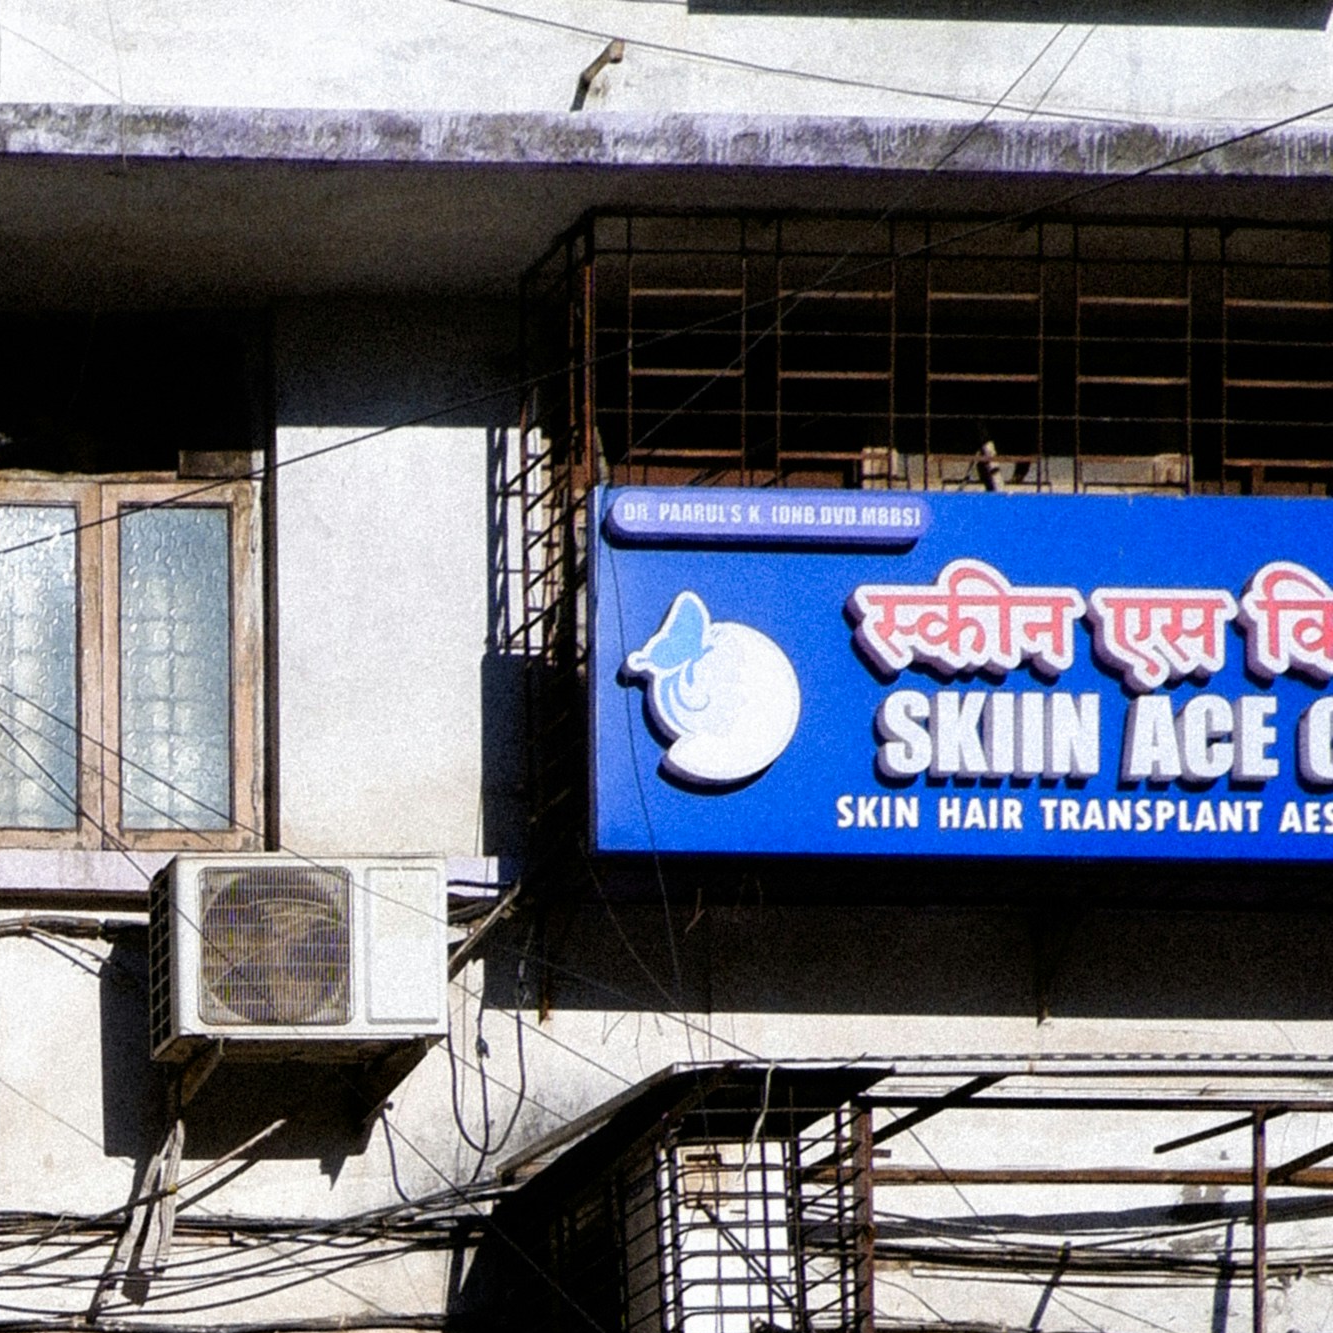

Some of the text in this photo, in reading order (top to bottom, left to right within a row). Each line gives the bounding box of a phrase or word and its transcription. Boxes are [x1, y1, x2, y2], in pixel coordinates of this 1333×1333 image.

[859, 562, 1081, 665] स्कीन
[1095, 593, 1232, 682] एस
[884, 689, 1100, 777] SKIIN
[1130, 694, 1280, 780] ACE
[836, 795, 919, 829] SKIN
[939, 797, 1023, 831] HAIR
[1040, 798, 1263, 832] TRANSPLANT
